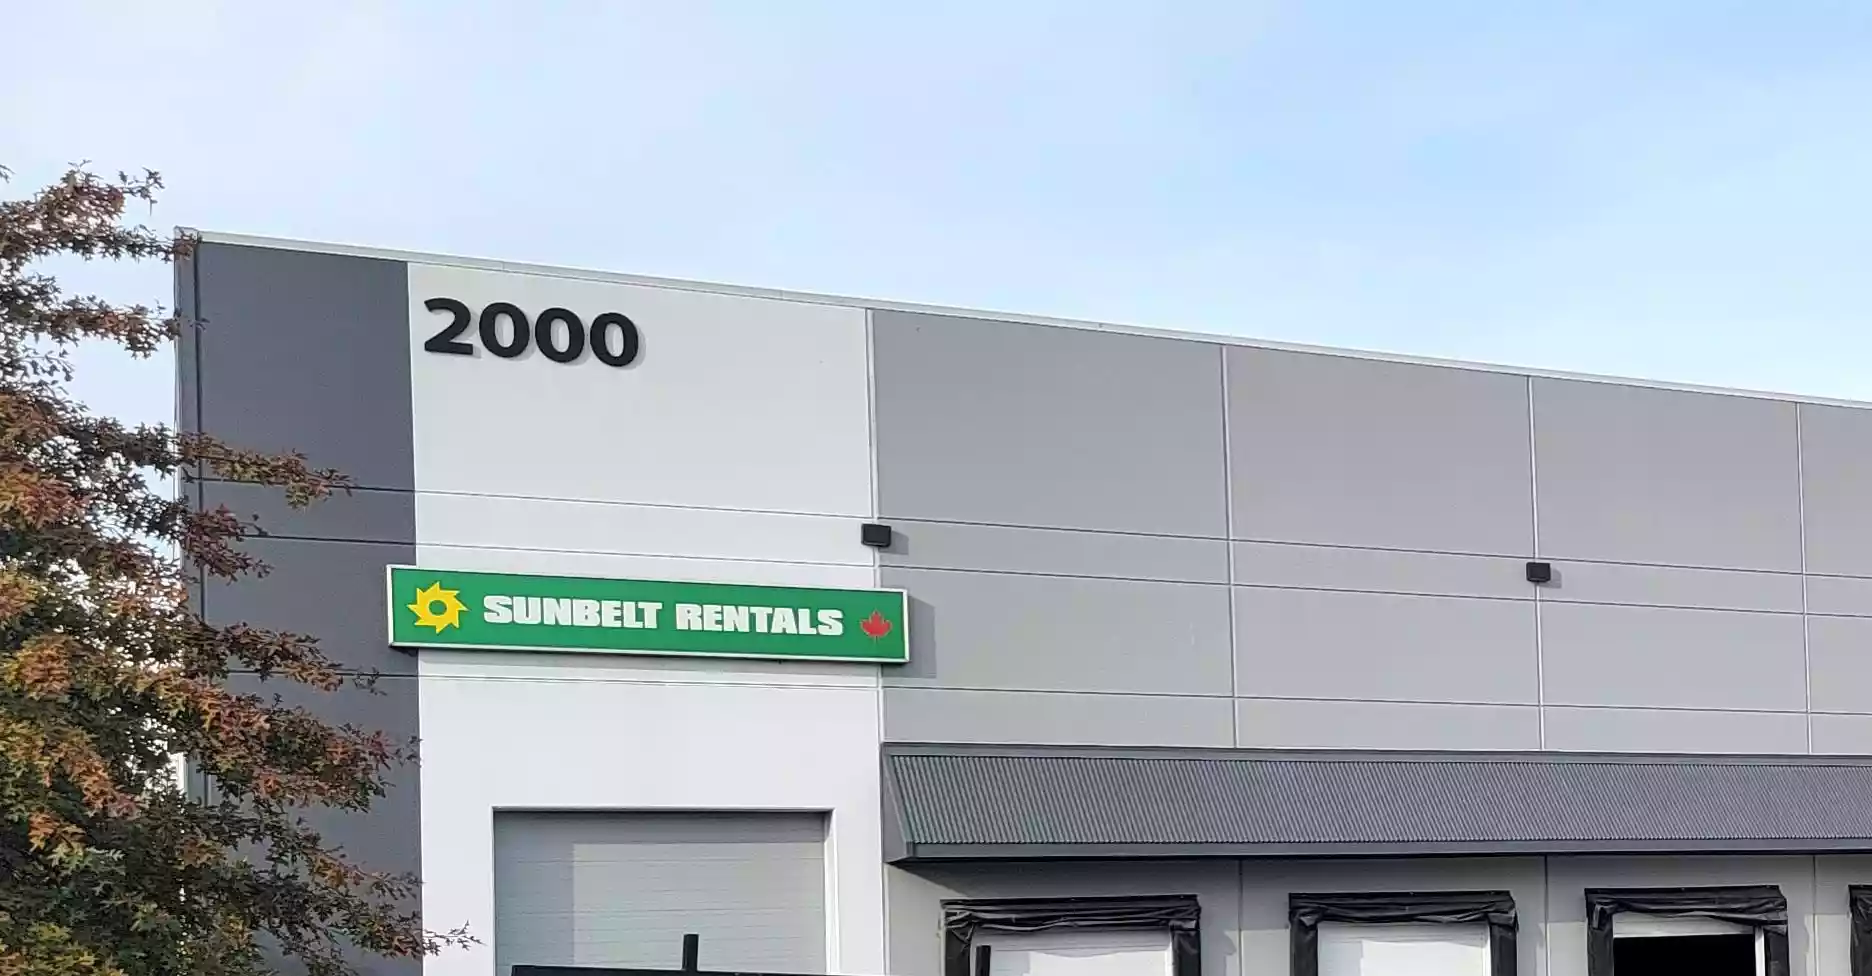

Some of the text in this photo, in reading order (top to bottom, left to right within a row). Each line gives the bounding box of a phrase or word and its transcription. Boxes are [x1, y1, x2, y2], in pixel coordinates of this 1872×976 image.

[423, 298, 640, 367] 2000
[484, 595, 844, 636] SUNBELT RENTALS
